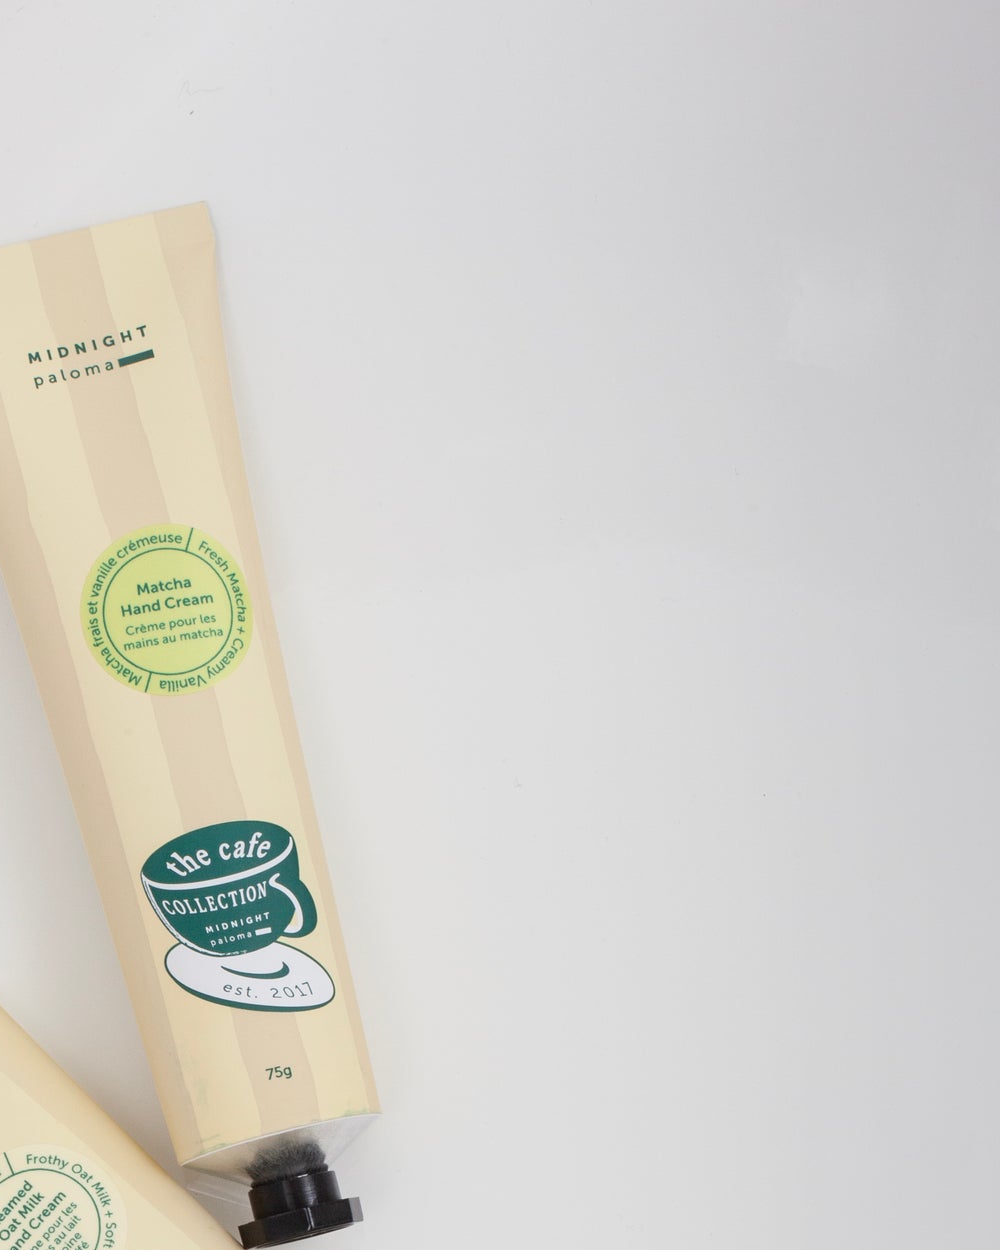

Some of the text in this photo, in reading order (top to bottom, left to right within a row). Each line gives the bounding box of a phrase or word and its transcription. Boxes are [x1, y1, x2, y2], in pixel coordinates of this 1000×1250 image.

[27, 325, 147, 364] MIDNIGHT
[33, 360, 114, 389] paloma
[198, 540, 229, 572] Fresh
[91, 557, 117, 598] vanille
[137, 578, 192, 596] Matcha
[88, 601, 98, 615] et
[121, 594, 214, 618] Hand Cream
[228, 572, 247, 622] Matcha
[88, 618, 104, 647] frais
[124, 628, 223, 651] mains au matcha
[126, 614, 216, 636] Crème pour les
[100, 647, 142, 686] Matcha
[207, 637, 244, 675] Creamy
[159, 675, 207, 692] Vanilla
[166, 831, 271, 878] the cafe
[162, 881, 268, 916] COLLECTION
[205, 911, 271, 934] MIDNIGHT
[210, 931, 253, 948] paloma
[222, 982, 313, 999] est. 2017
[265, 1066, 293, 1081] 75g
[0, 1191, 45, 1241] Oat Milk
[26, 1154, 69, 1169] Frothy
[71, 1164, 93, 1183] Oat
[92, 1182, 112, 1207] Milk
[103, 1222, 117, 1248] Soft
[29, 1191, 67, 1230] Cream
[43, 1217, 64, 1242] pour
[64, 1202, 78, 1217] les
[54, 1232, 66, 1245] au
[65, 1215, 81, 1232] lait
